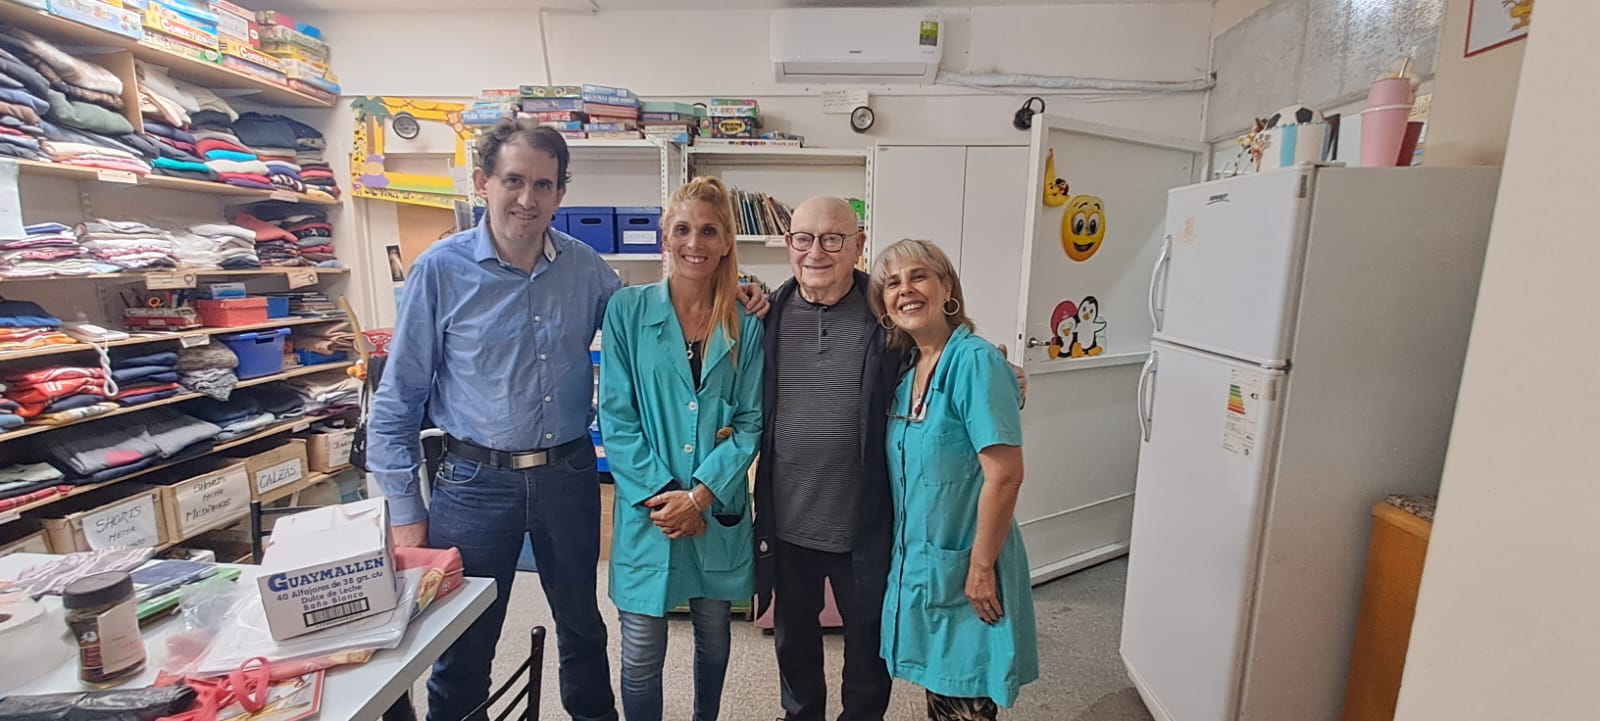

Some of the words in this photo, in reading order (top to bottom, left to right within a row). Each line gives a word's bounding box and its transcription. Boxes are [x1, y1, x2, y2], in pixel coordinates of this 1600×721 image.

[259, 467, 297, 489] CALZAS
[95, 505, 142, 533] SHORTS
[268, 556, 384, 592] GUAYMALLEN
[277, 593, 289, 601] 40
[291, 584, 330, 599] Alfajores
[331, 580, 342, 589] de
[344, 577, 354, 586] 38
[301, 593, 324, 605] Dulce
[327, 589, 337, 598] de
[340, 584, 363, 595] Leche
[303, 600, 328, 611] Baño
[331, 591, 364, 604] Blanco
